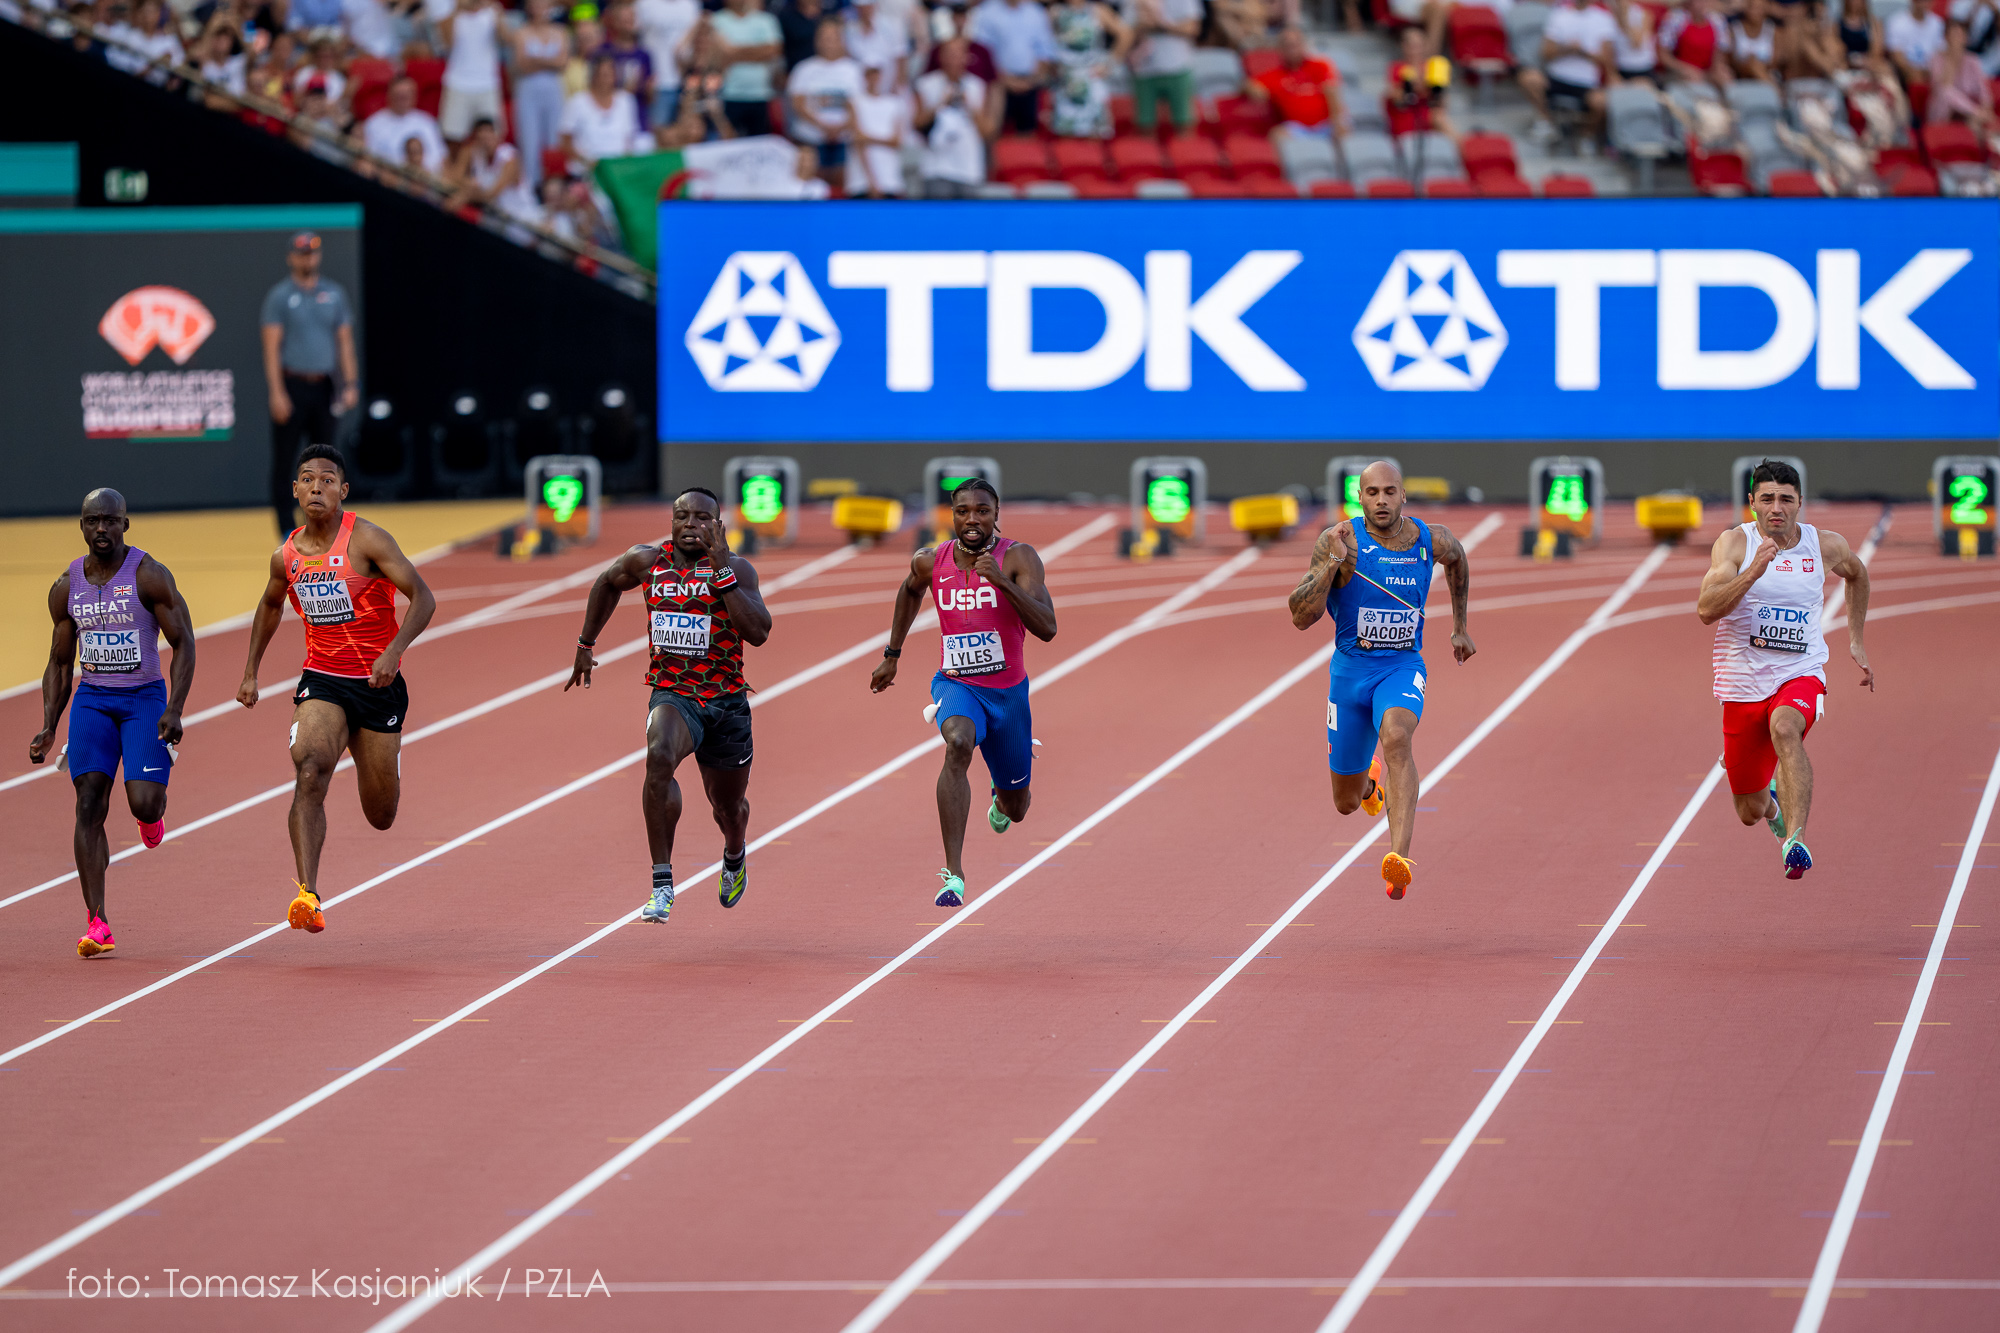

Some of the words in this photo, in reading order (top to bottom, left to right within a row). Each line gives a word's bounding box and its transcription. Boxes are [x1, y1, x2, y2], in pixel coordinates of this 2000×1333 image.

[828, 250, 1307, 392] TDK
[1497, 249, 1977, 390] TDK
[543, 474, 583, 523] 9
[741, 474, 783, 523] 8
[1147, 475, 1191, 523] 6
[1545, 475, 1589, 522] 4
[1949, 475, 1988, 525] 2
[299, 571, 338, 584] JAPAN
[1385, 576, 1417, 586] ITALIA
[305, 581, 344, 597] TDK
[651, 582, 711, 597] KENYA
[316, 597, 350, 613] BROWN
[938, 586, 998, 611] USA
[73, 599, 130, 617] GREAT
[1771, 607, 1810, 625] TDK
[75, 612, 134, 628] BRITAIN
[665, 614, 706, 631] TDK
[1377, 610, 1416, 624] TDK
[93, 631, 135, 646] TDK
[653, 629, 706, 646] OMANYALA
[955, 632, 997, 649] TDK
[1361, 625, 1414, 640] JACOBS
[1759, 624, 1805, 641] KOPEĆ
[1768, 641, 1801, 650] BUDAPEST
[951, 648, 993, 667] LYLES
[960, 665, 994, 675] BUDAPEST
